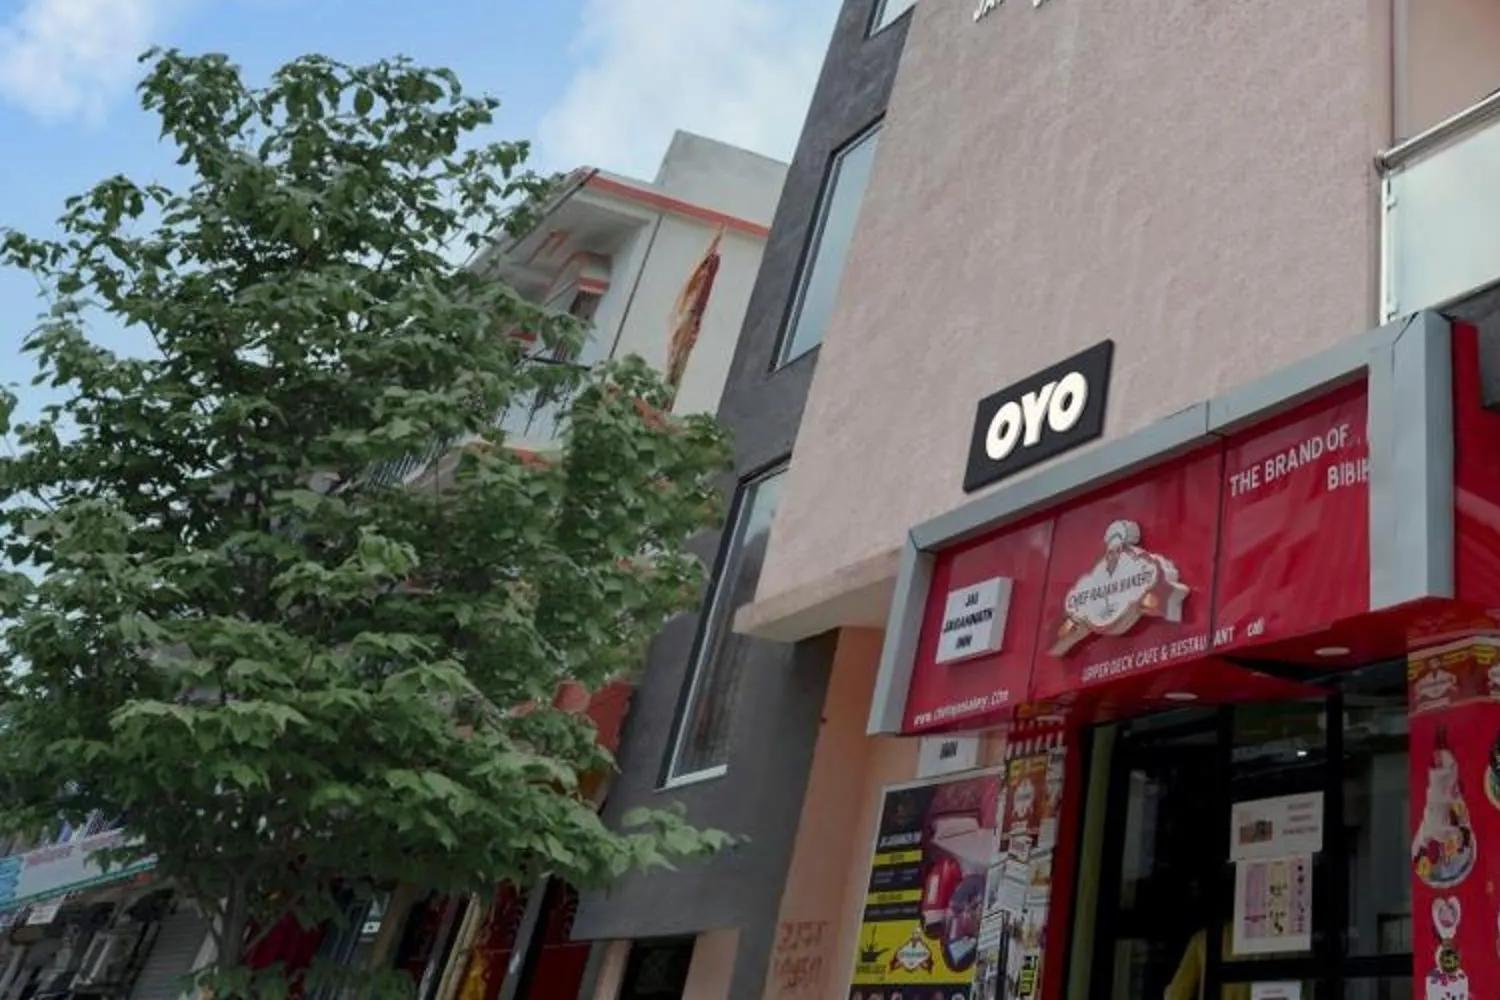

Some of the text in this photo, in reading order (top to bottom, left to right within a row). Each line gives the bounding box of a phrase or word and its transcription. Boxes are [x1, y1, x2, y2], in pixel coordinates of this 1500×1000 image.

[985, 370, 1089, 461] OYO
[1229, 423, 1350, 498] THE BRAND OF
[965, 591, 979, 606] JAI
[1169, 625, 1236, 657] RESTAUANT
